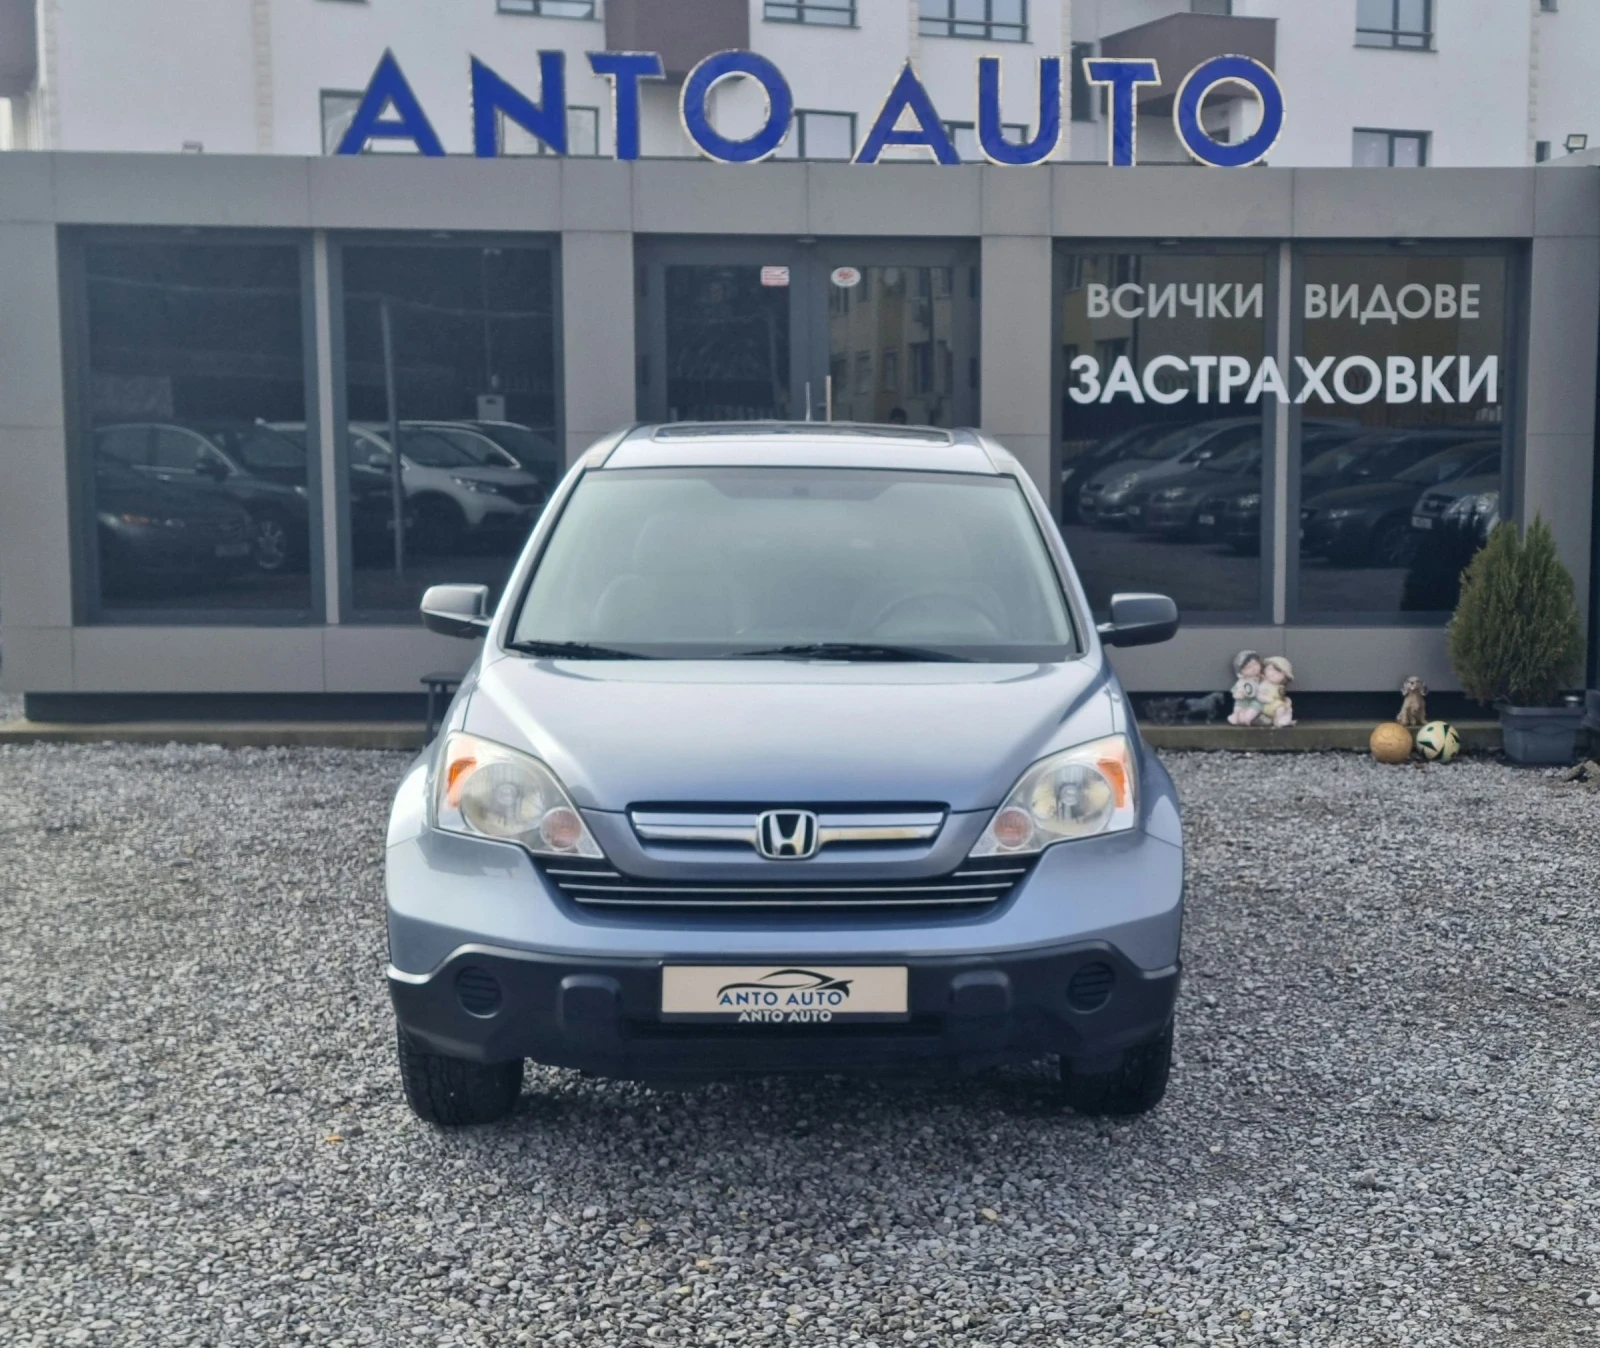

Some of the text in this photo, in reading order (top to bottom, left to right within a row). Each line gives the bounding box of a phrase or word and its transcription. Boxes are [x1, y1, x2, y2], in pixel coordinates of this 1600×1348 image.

[337, 48, 1286, 168] ANTO AUTO
[1087, 283, 1480, 325] ВСИЧКИ ВИДОВЕ
[1069, 354, 1498, 404] ЗАСТРАХОВКИ
[719, 992, 842, 1006] ANTO AUTO
[738, 1010, 832, 1023] ANTO AUTO
